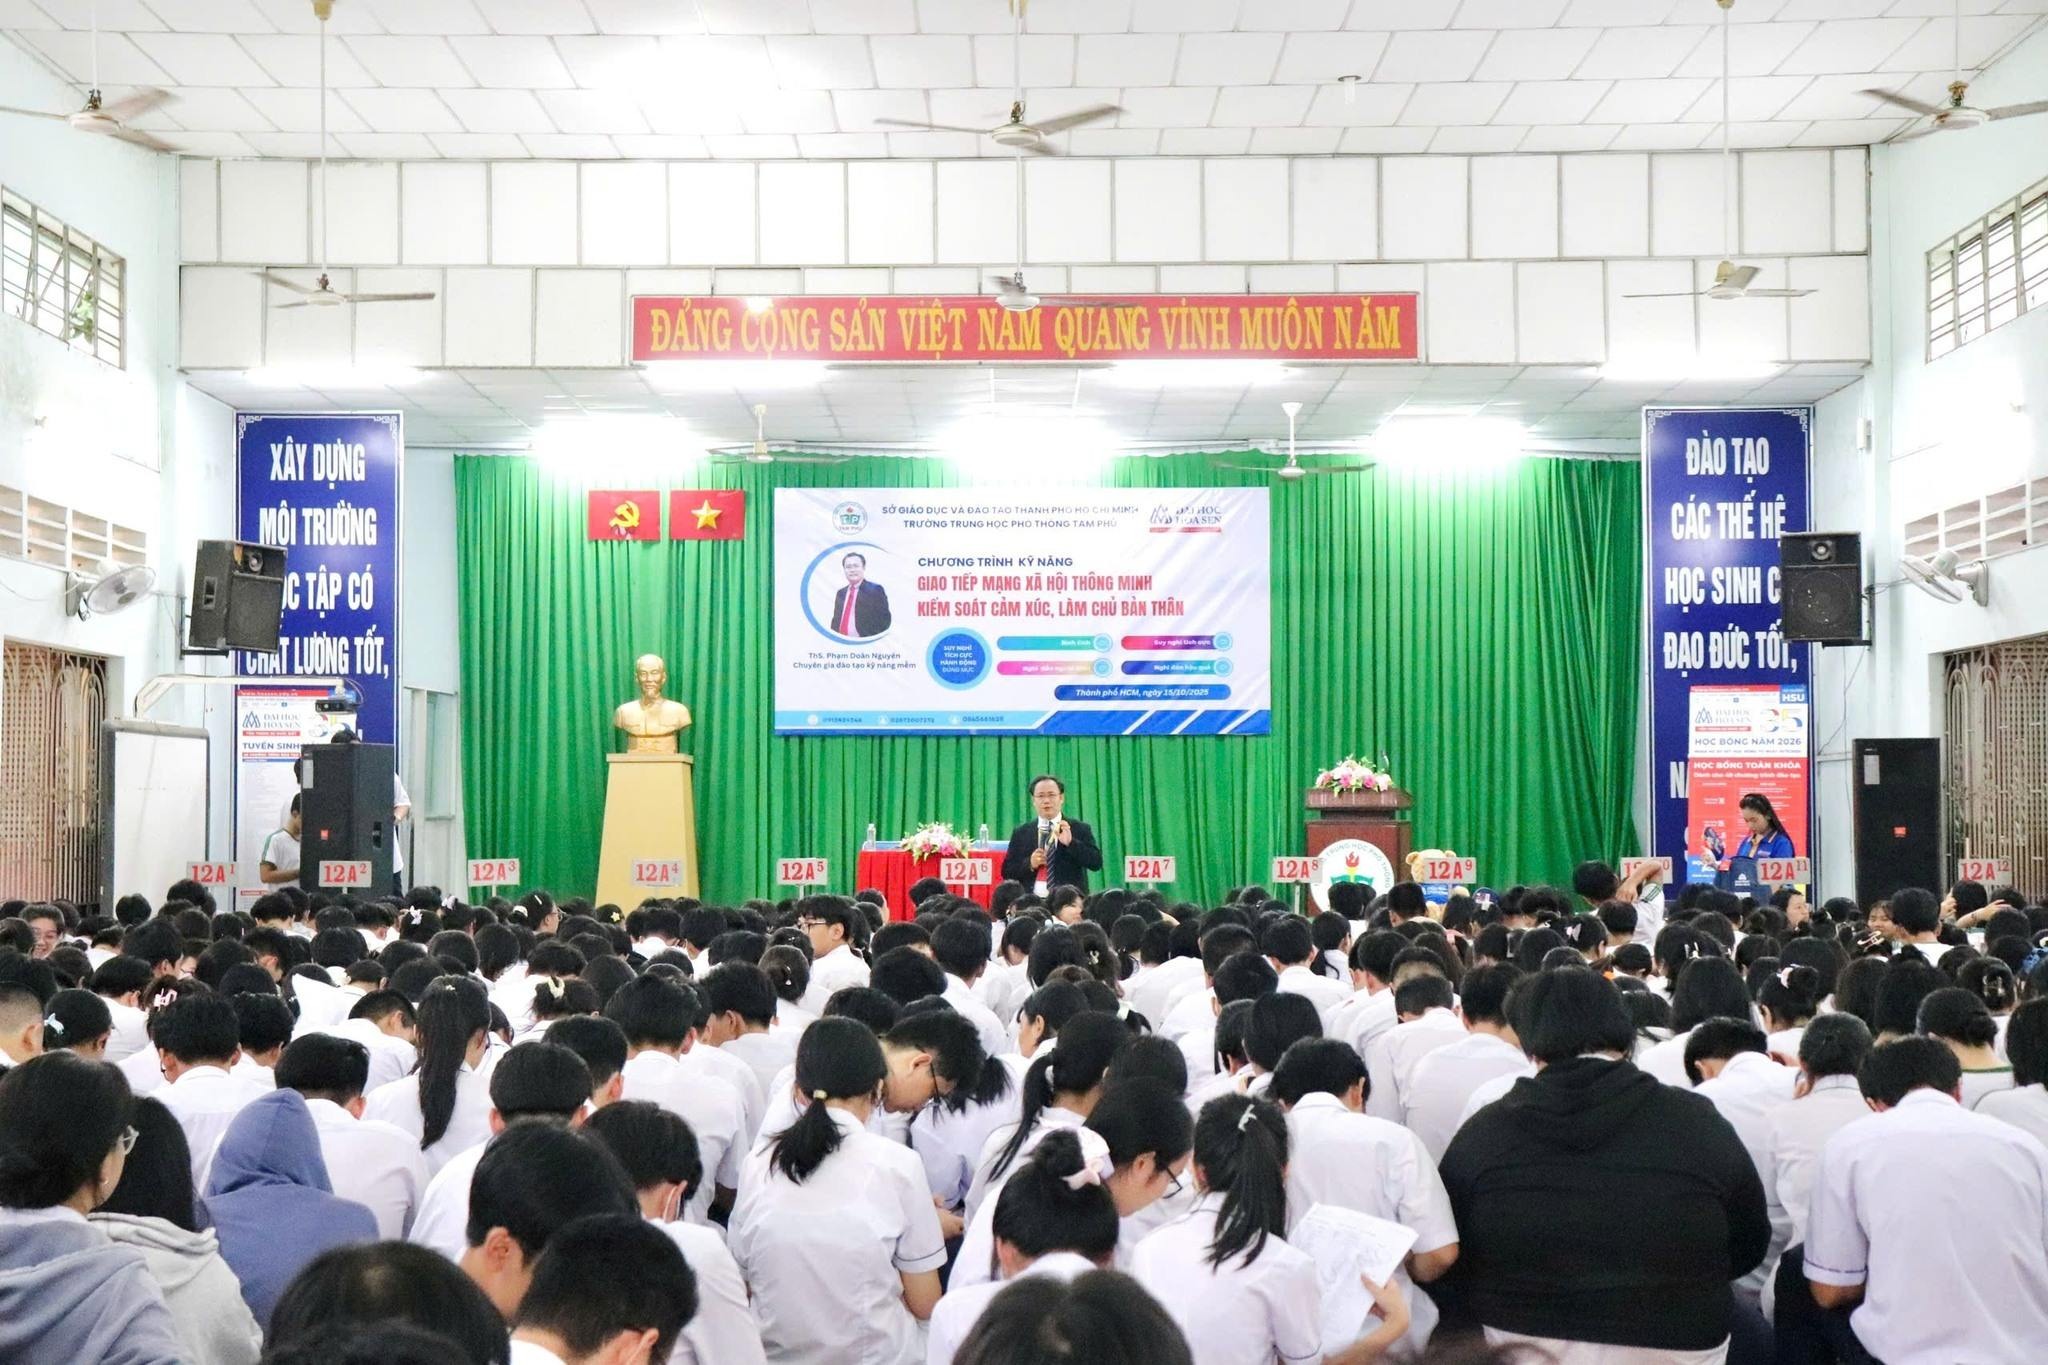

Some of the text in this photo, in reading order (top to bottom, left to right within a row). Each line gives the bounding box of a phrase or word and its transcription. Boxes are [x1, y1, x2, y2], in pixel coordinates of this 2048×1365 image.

[650, 297, 733, 351] ĐẢNG
[829, 297, 887, 351] SẢN
[898, 298, 967, 360] VIỆT
[977, 307, 1042, 351] NAM
[1054, 306, 1151, 358] QUANG
[1239, 298, 1325, 351] MUÔN
[1333, 297, 1401, 350] NĂM
[270, 435, 366, 490] XÂY DỰNG
[1685, 430, 1770, 484] ĐÀO TẠO
[259, 500, 378, 546] MÔI TRƯỜNG
[951, 519, 984, 528] TRUNG
[1671, 494, 1712, 541] CÁC
[1716, 490, 1755, 540] THẾ
[917, 572, 1153, 594] GIAO TIẾP MẠNG XÃ HỘI THÔNG MINH
[918, 555, 975, 567] CHƯƠNG
[977, 555, 1013, 567] TRÌNH
[305, 564, 343, 619] TẬP
[348, 563, 374, 610] CÓ
[954, 597, 987, 617] SOÁT
[1025, 597, 1055, 618] XÚC,
[1058, 597, 1088, 617] LÀM
[1151, 596, 1185, 617] THÂN
[1664, 566, 1705, 613] HỌC
[1711, 566, 1762, 605] SINH
[1663, 631, 1705, 678] ĐẠO
[1709, 623, 1750, 669] ĐỨC
[1119, 689, 1141, 697] HCM,
[1142, 689, 1163, 698] ngày
[1164, 688, 1209, 696] 15/10/2025
